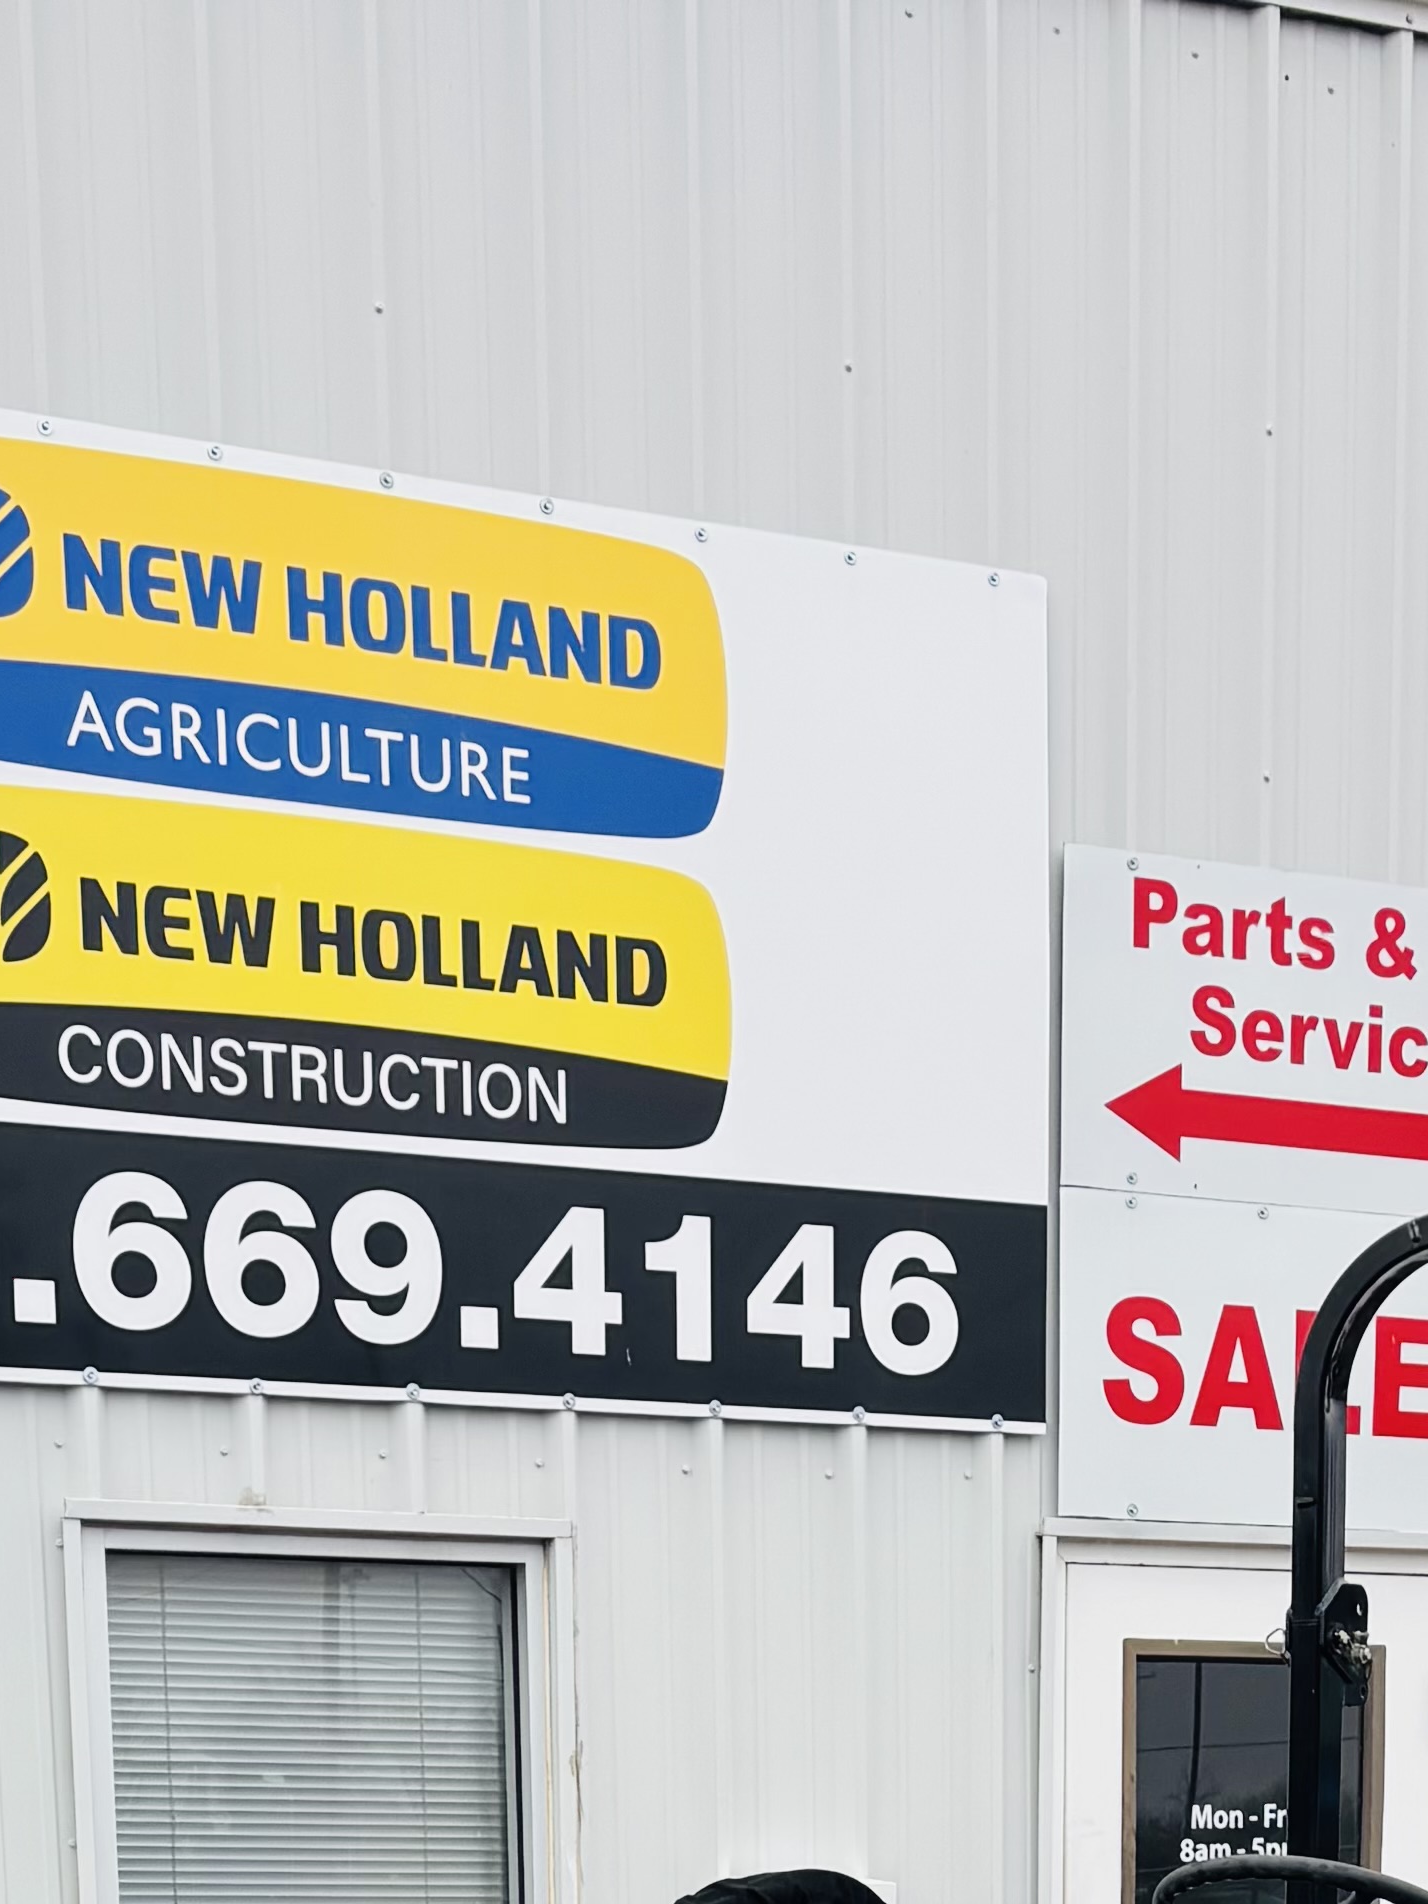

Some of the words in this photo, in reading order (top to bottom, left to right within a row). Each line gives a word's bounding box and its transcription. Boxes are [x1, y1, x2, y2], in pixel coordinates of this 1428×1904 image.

[63, 534, 260, 634] NEW
[287, 567, 661, 692] HOLLAND
[67, 689, 533, 806] AGRICULTURE
[80, 877, 275, 968] NEW
[300, 900, 667, 1008] HOLLAND
[1132, 876, 1335, 971] Parts
[1365, 907, 1417, 981] &
[58, 1023, 569, 1127] CONSTRUCTION
[1179, 1837, 1232, 1863] 8am
[1190, 1803, 1244, 1830] Mon
[1263, 1802, 1288, 1829] Fr
